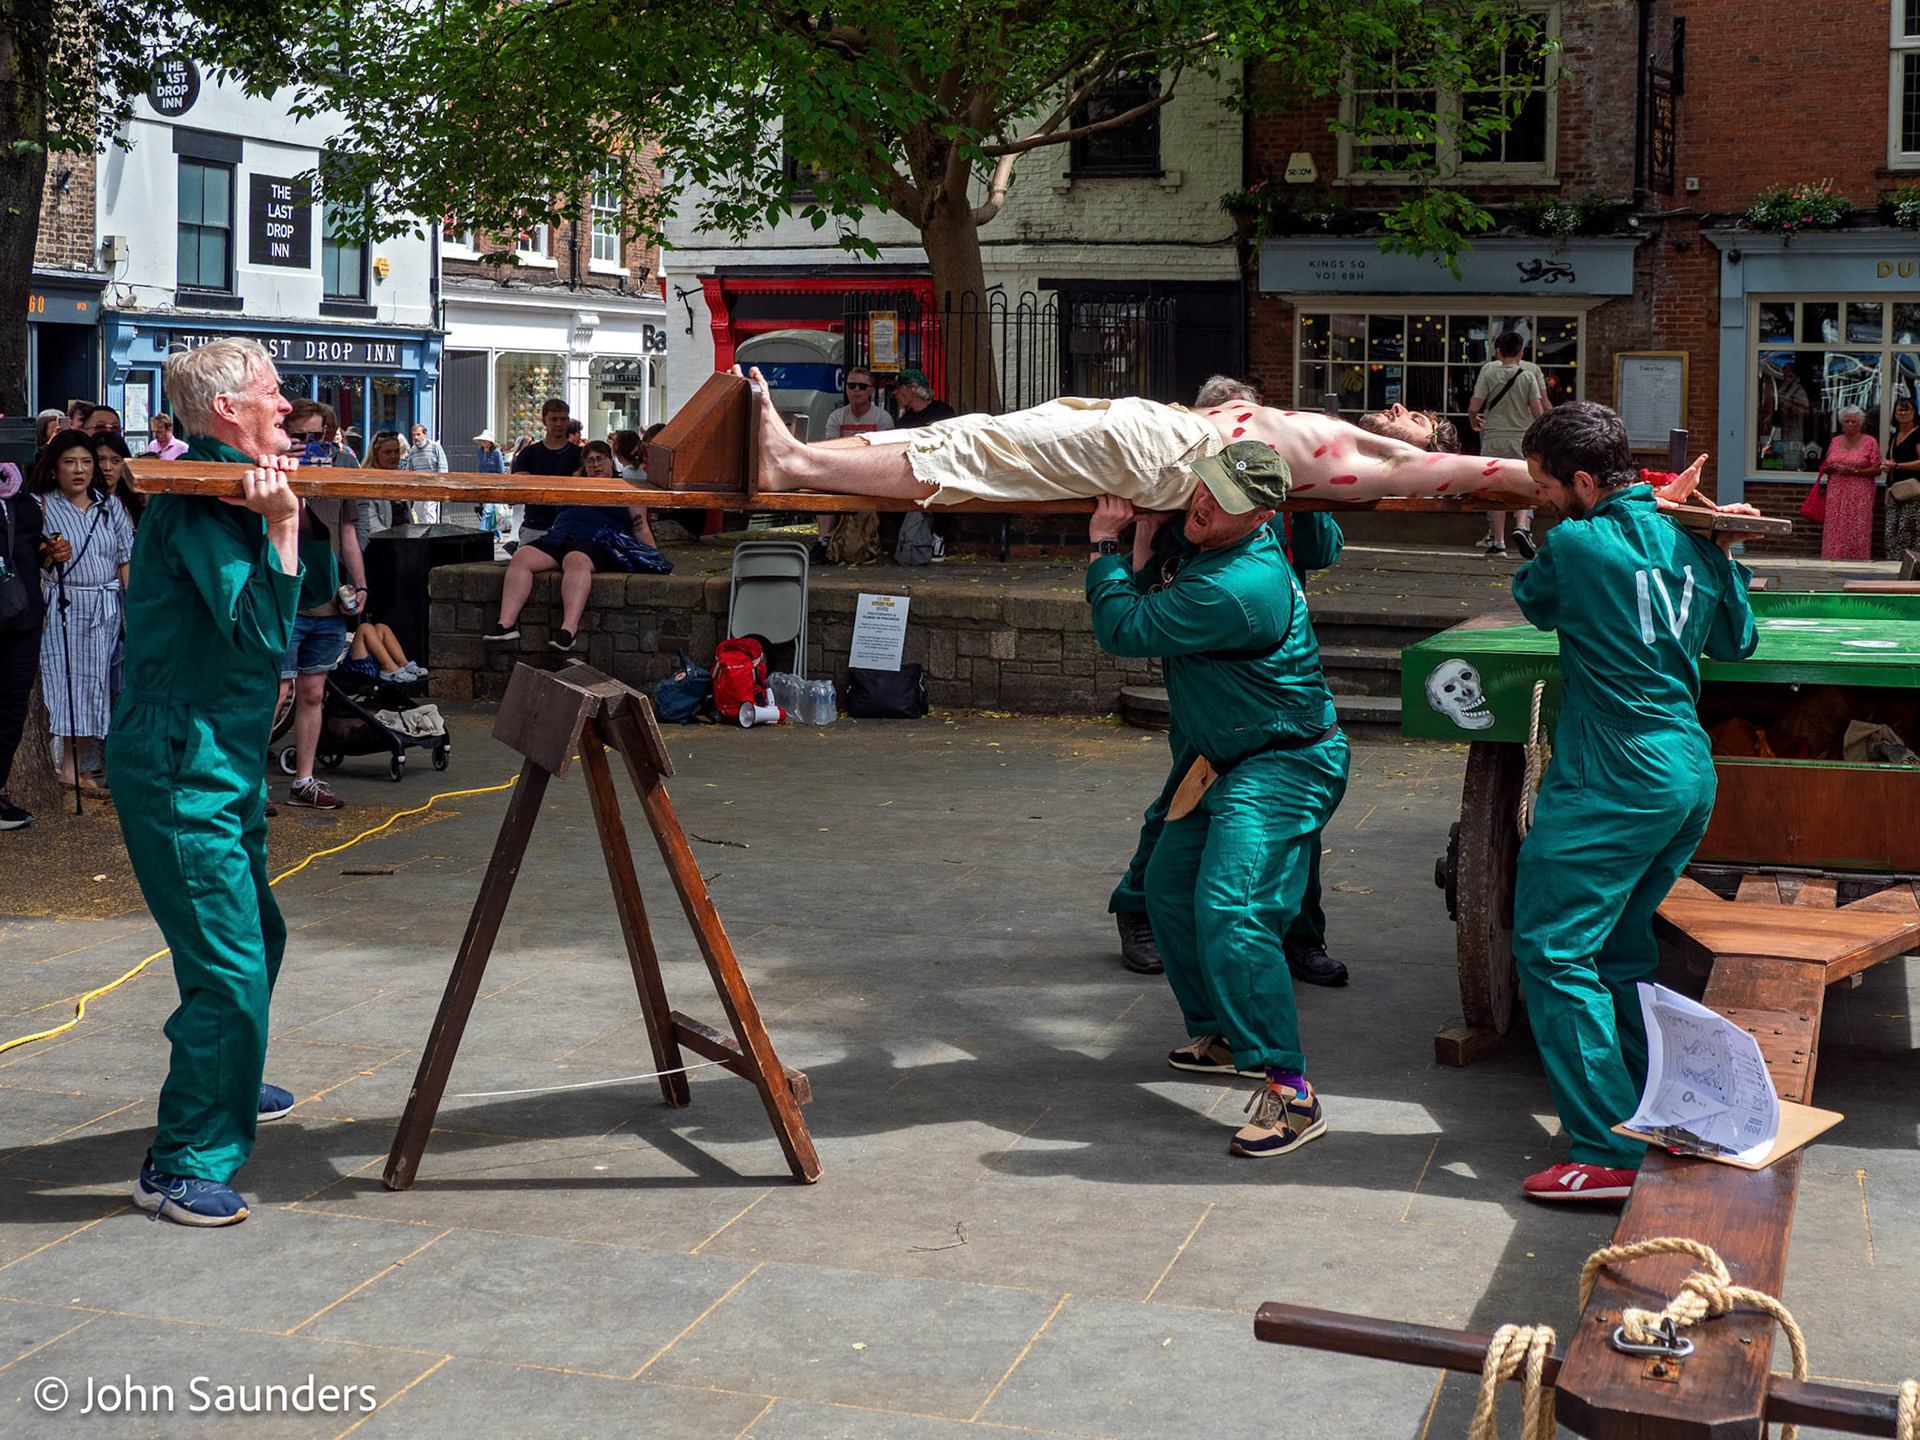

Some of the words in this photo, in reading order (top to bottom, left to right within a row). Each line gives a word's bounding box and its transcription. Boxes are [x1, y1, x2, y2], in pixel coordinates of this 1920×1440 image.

[158, 72, 187, 84] AST
[157, 85, 189, 97] DROP
[162, 97, 183, 108] INN
[271, 184, 292, 200] THE
[267, 203, 294, 220] LAST
[266, 222, 294, 239] DROP
[271, 242, 290, 258] INN
[1309, 260, 1345, 269] KINGS
[1350, 260, 1370, 269] SQ.
[1877, 261, 1920, 278] DU
[1315, 271, 1336, 280] YO1
[305, 340, 353, 361] DROP
[366, 343, 396, 362] INN
[128, 440, 145, 453] PUB
[1635, 565, 1694, 645] IV
